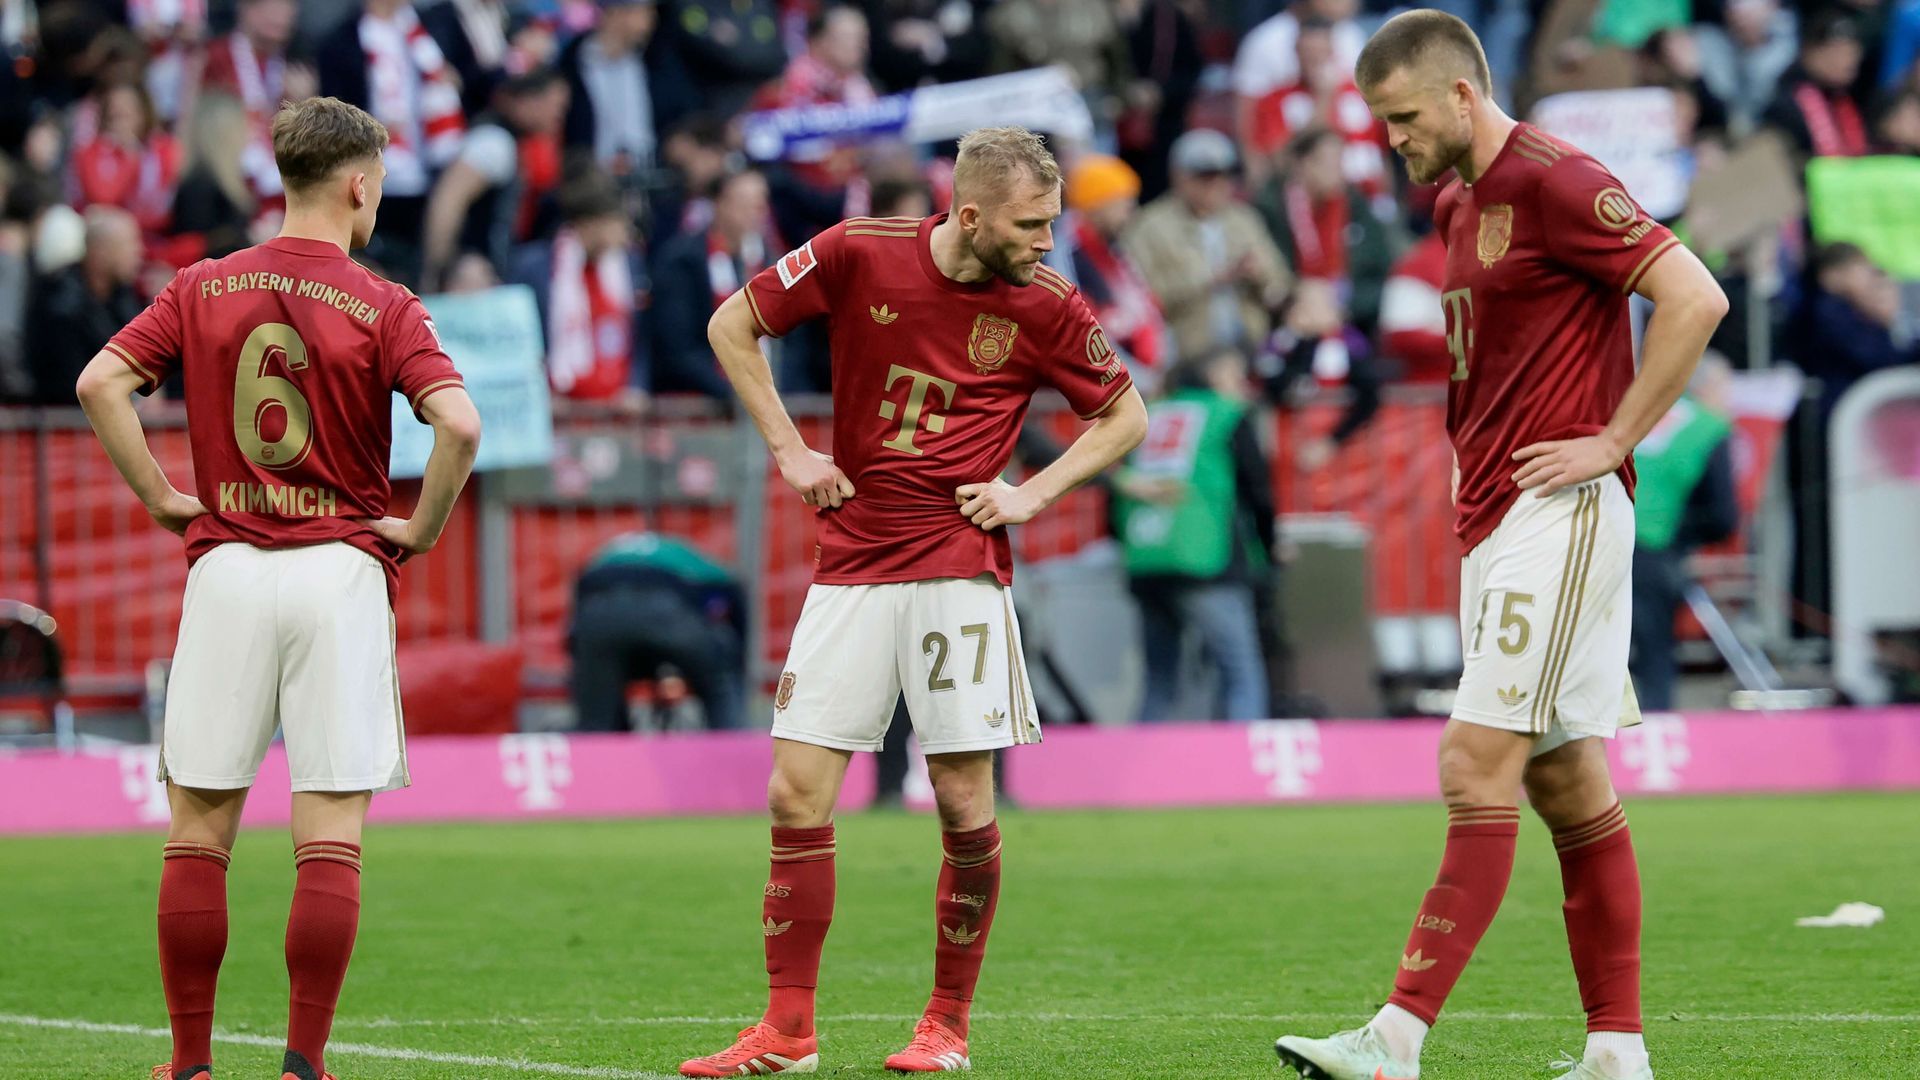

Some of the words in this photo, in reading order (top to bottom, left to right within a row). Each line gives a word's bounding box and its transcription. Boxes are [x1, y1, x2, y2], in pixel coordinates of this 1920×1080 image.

[201, 278, 223, 299] FC
[227, 272, 294, 293] BAYERN
[296, 279, 381, 325] MÜNCHEN
[984, 324, 1006, 341] 125
[234, 322, 314, 470] 6
[878, 363, 957, 456] T
[219, 482, 336, 517] KIMMICH
[922, 622, 991, 693] 27
[1417, 914, 1456, 934] 125
